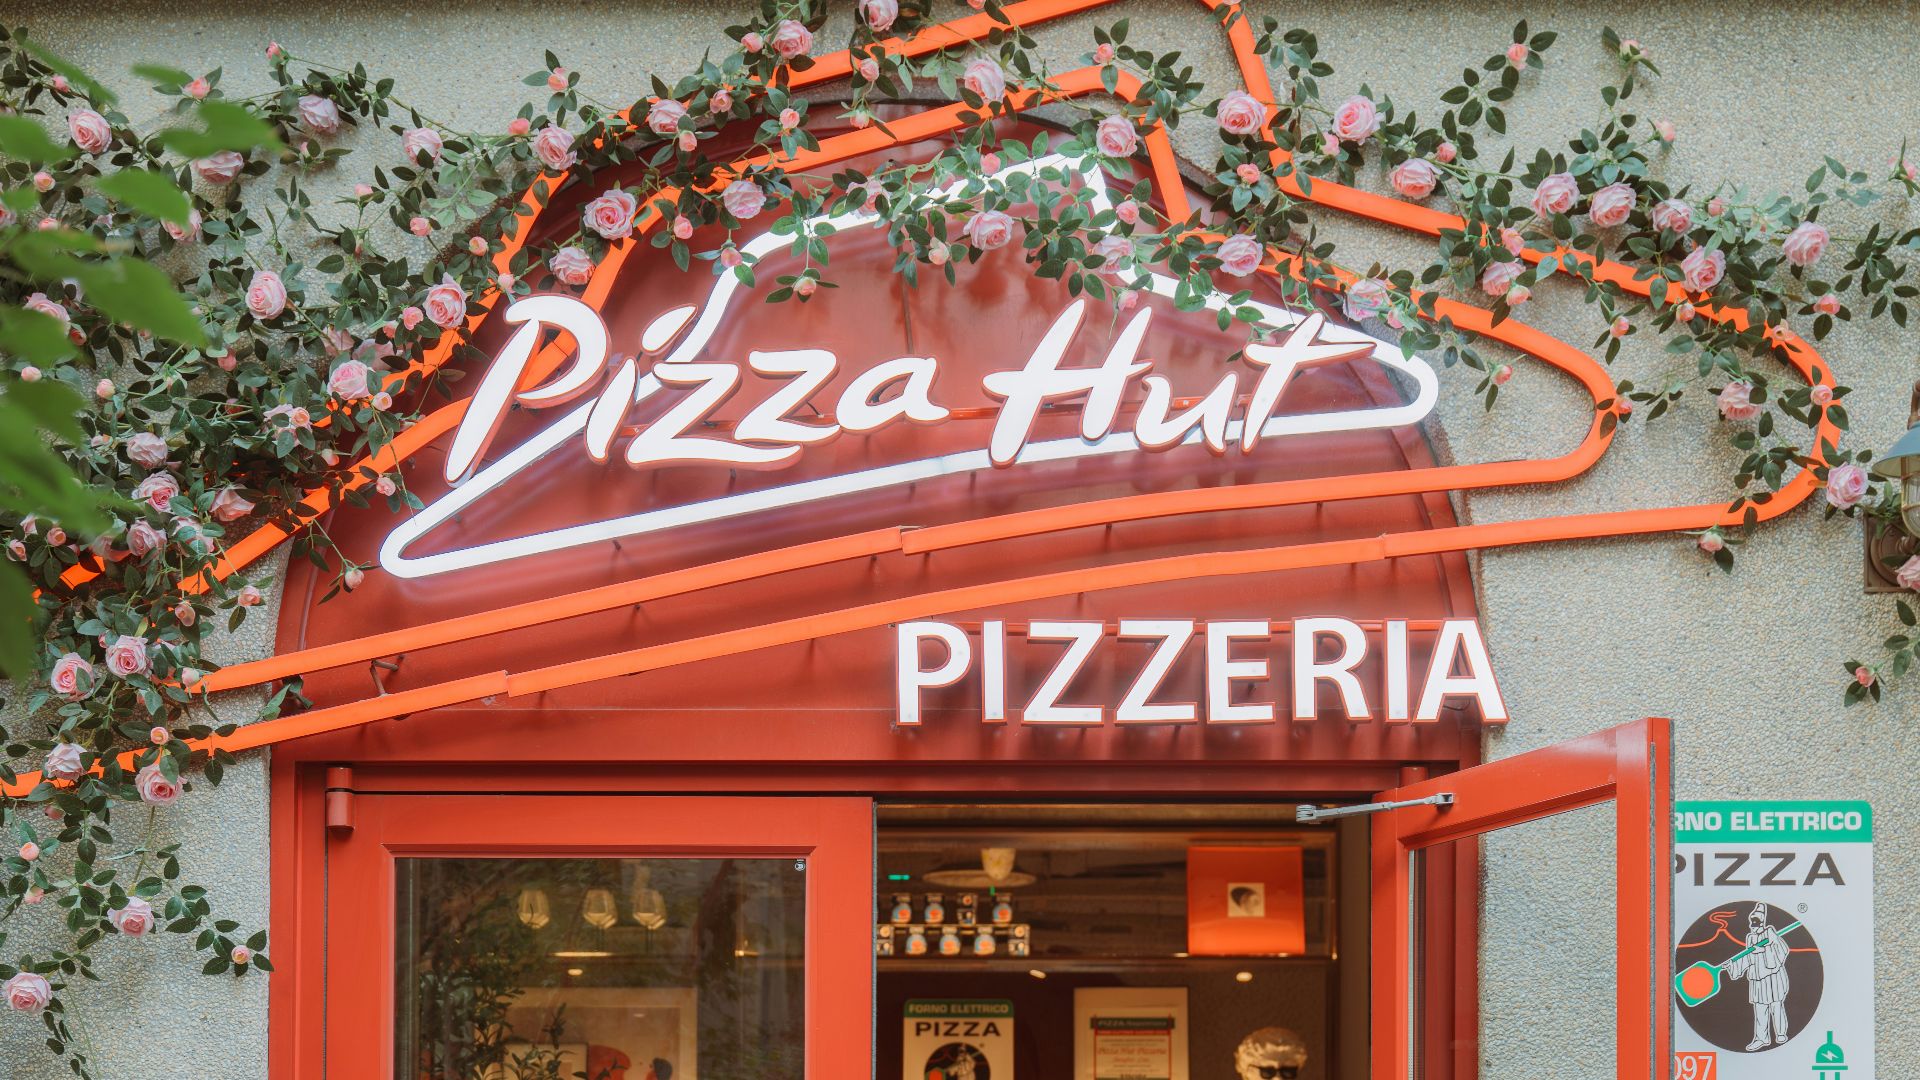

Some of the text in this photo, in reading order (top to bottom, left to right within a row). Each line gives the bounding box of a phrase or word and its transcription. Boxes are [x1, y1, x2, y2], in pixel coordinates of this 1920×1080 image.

[443, 294, 1377, 488] Pizza Hut
[896, 617, 1509, 725] PIZZERIA
[1730, 811, 1862, 831] ELETTRICO
[908, 1004, 1009, 1014] FORNO ELETTRICO
[915, 1022, 1001, 1037] PIZZA
